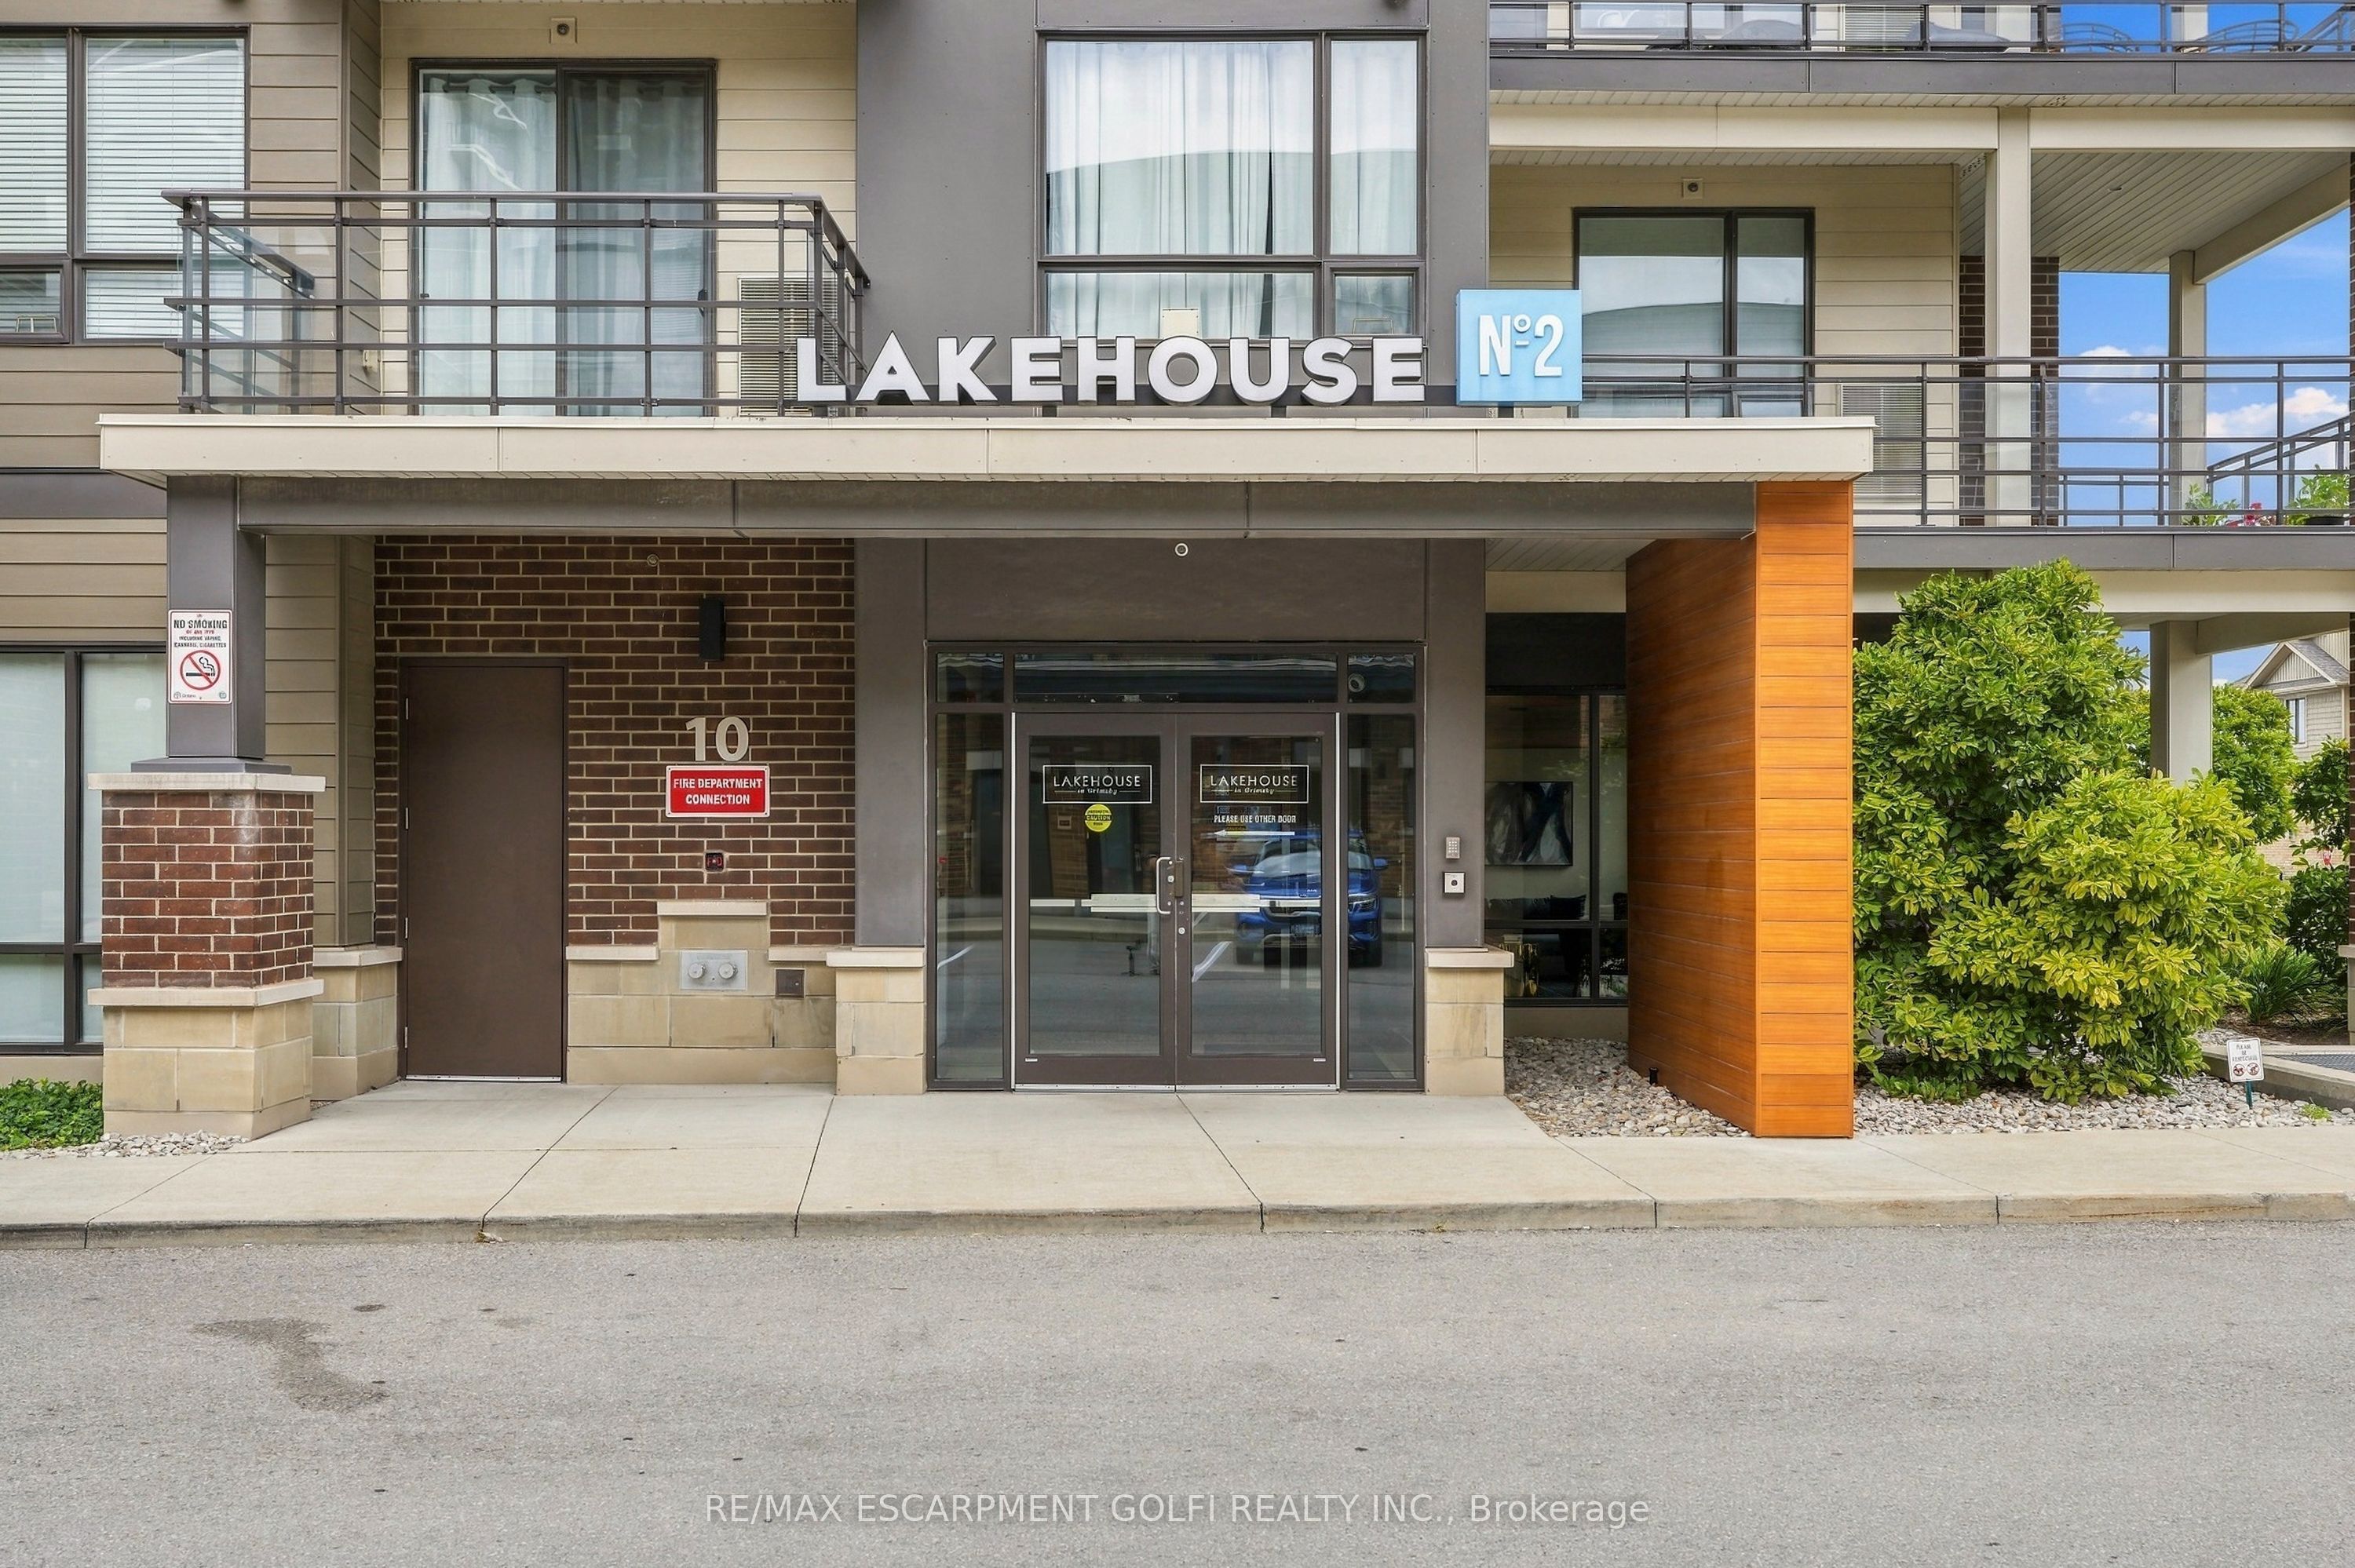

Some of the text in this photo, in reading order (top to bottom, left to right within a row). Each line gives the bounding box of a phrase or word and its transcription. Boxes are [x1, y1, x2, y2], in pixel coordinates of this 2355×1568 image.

[796, 330, 1426, 405] LAKEHOUSE
[173, 619, 228, 629] NO SMOKING
[685, 716, 749, 762] 10
[674, 779, 763, 789] FIRE DEPARTMENT
[1053, 775, 1141, 787] LAKEHOUSE
[1210, 775, 1298, 787] LAKEHOUSE
[1087, 787, 1118, 796] Grimsby
[1244, 787, 1275, 796] Grimsby
[685, 794, 750, 804] CONNECTION
[1214, 815, 1297, 823] PLEASE USE OTHER DOOR
